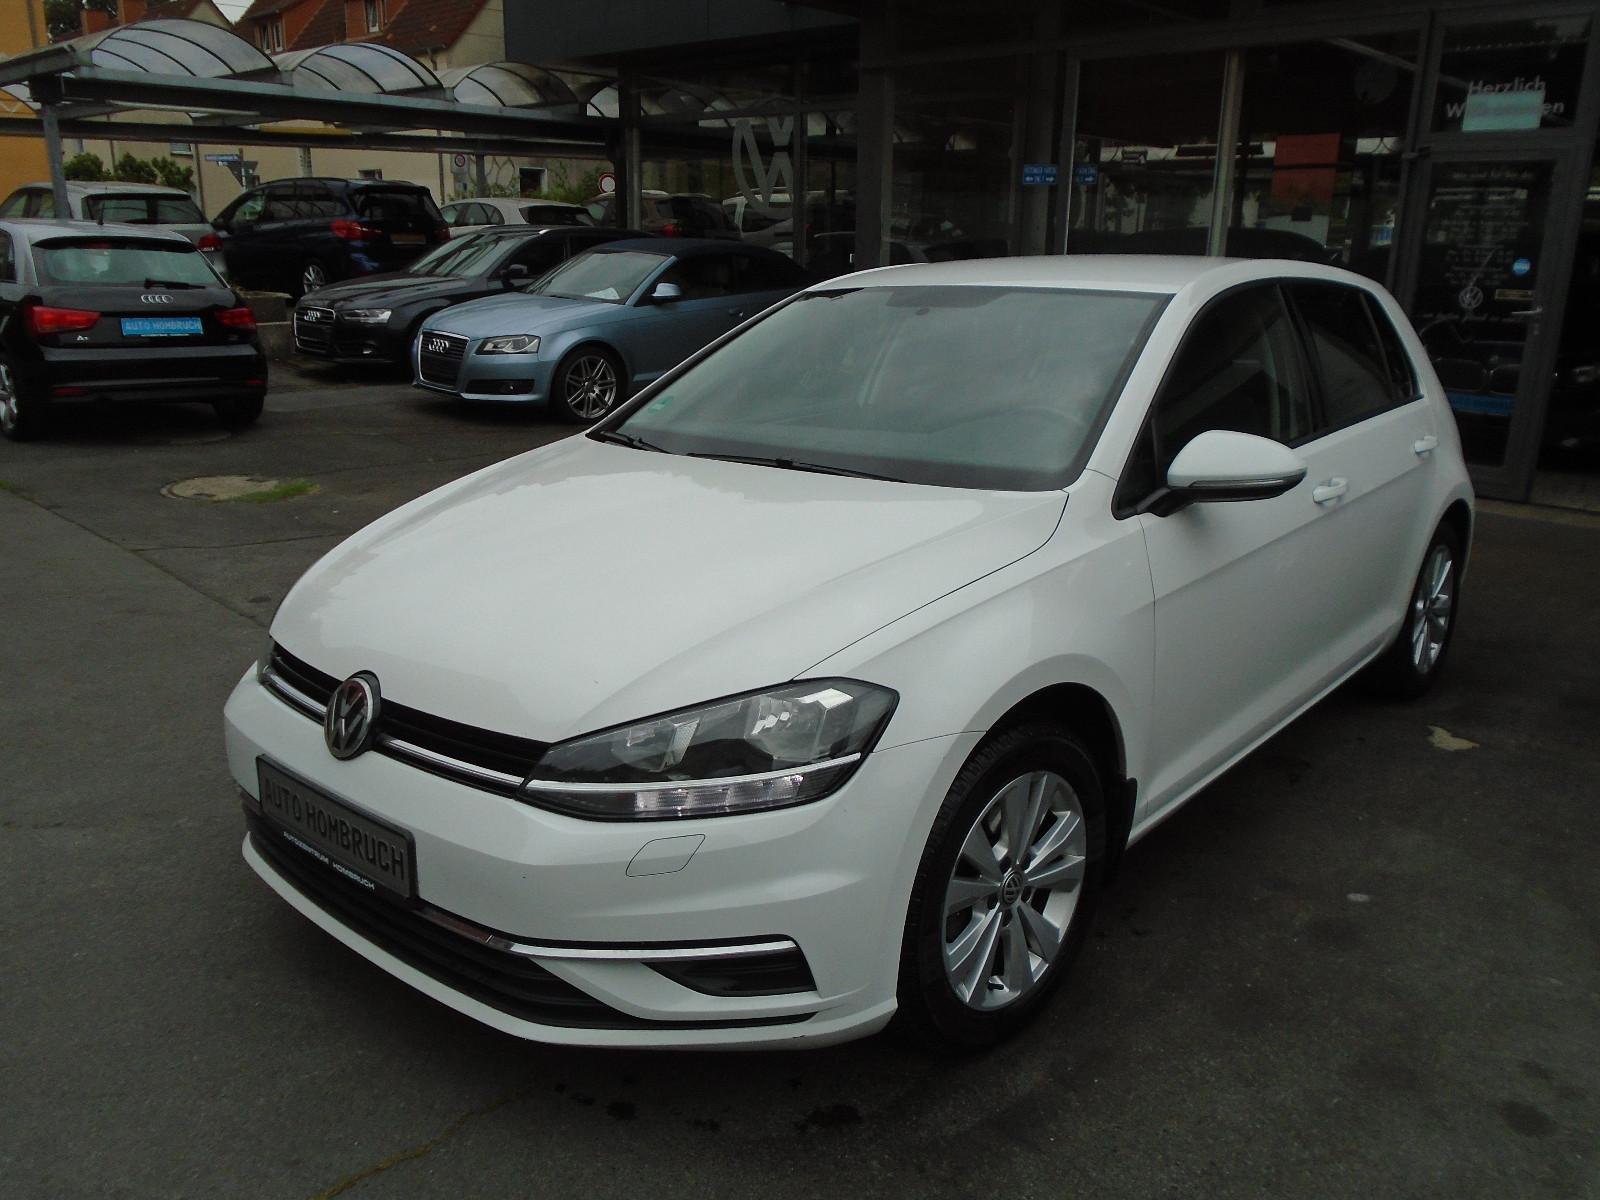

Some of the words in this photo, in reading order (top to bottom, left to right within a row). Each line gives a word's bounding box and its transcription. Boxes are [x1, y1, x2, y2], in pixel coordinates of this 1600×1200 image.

[1468, 74, 1547, 95] Herzlich
[125, 320, 151, 330] AUTO
[152, 319, 200, 330] HOMBRUCH
[264, 777, 301, 820] AUTO
[306, 805, 405, 881] HOMBRUCH
[332, 861, 376, 890] HOMBRUCH
